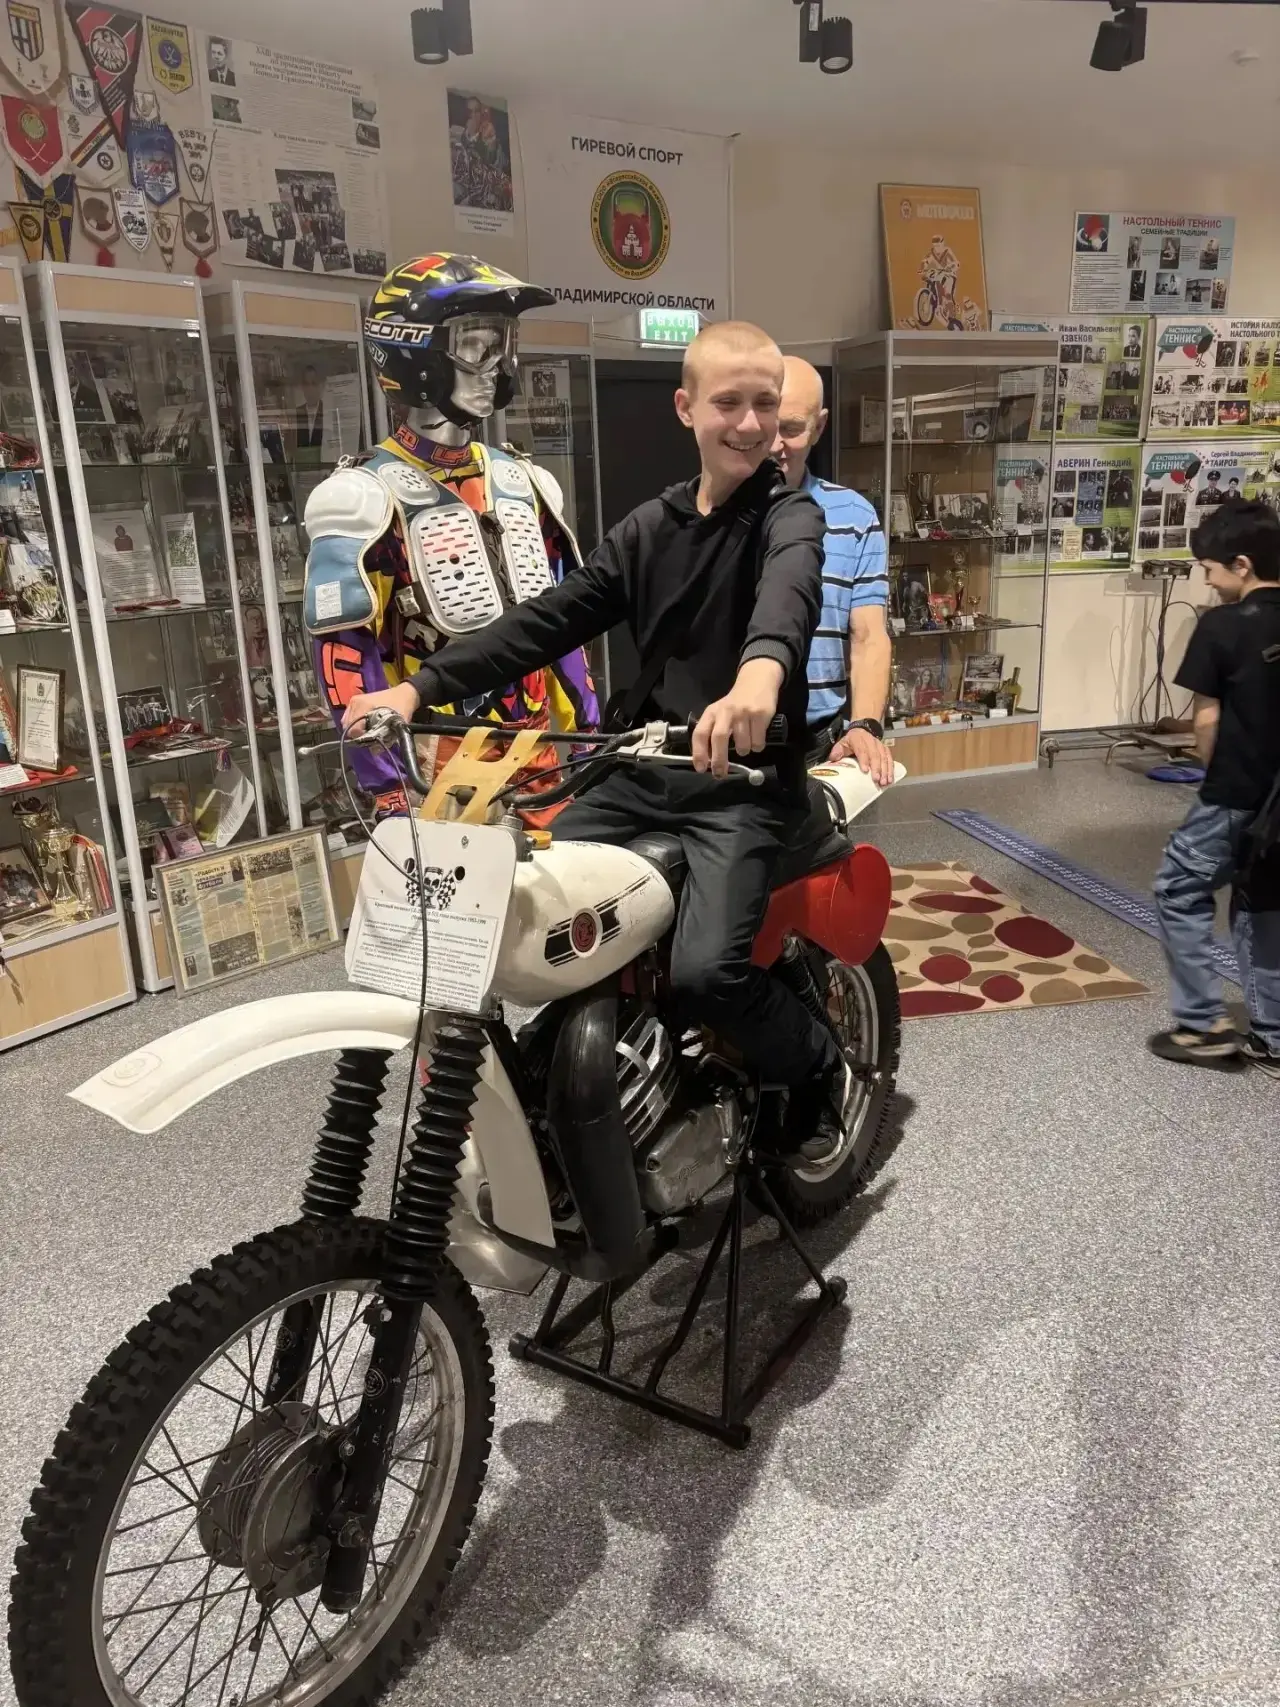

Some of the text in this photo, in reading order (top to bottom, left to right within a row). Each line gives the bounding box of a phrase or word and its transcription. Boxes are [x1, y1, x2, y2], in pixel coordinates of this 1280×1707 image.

[571, 136, 684, 166] ГИРЕВОЙ СПОРТ
[1123, 216, 1222, 229] НАСТОЛЬНЫЙ ТЕННИС
[1140, 228, 1208, 237] СЕМЕЙНЫЕ ТРАДИЦИИ
[657, 294, 715, 310] ОБЛАСТИ
[647, 315, 694, 328] ВЫХОД
[1231, 322, 1260, 330] ИСТОРИЯ
[1060, 324, 1078, 333] Иван
[654, 331, 688, 342] EXIT
[1165, 333, 1196, 343] ТЕННИС
[1230, 330, 1276, 338] НАСТОЛЬНОГО
[1058, 457, 1132, 468] АВЕРИН Геннадий
[1151, 461, 1185, 471] ТЕННИС
